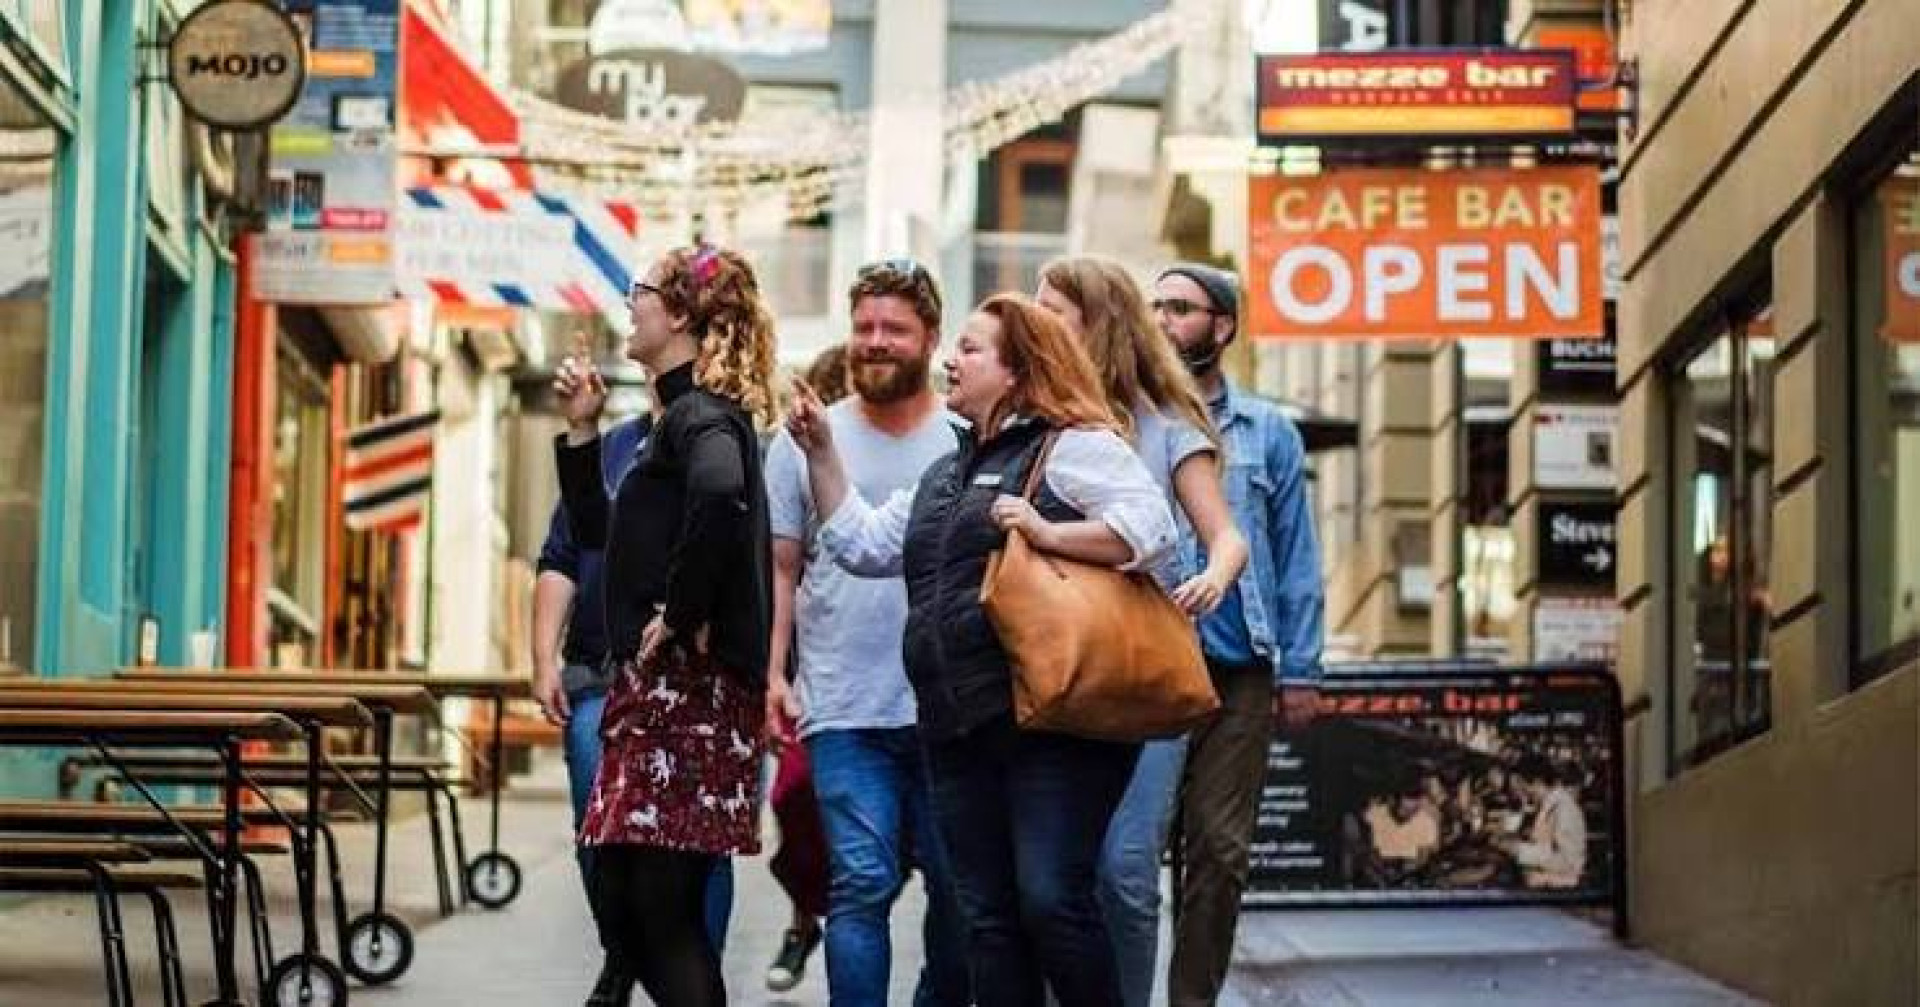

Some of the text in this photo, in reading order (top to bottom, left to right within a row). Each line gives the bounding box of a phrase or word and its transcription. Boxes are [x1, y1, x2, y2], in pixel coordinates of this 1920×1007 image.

[187, 54, 287, 79] MOJO
[1278, 60, 1556, 89] mezze bar
[1273, 184, 1574, 232] CAFE BAR
[1269, 242, 1580, 323] OPEN
